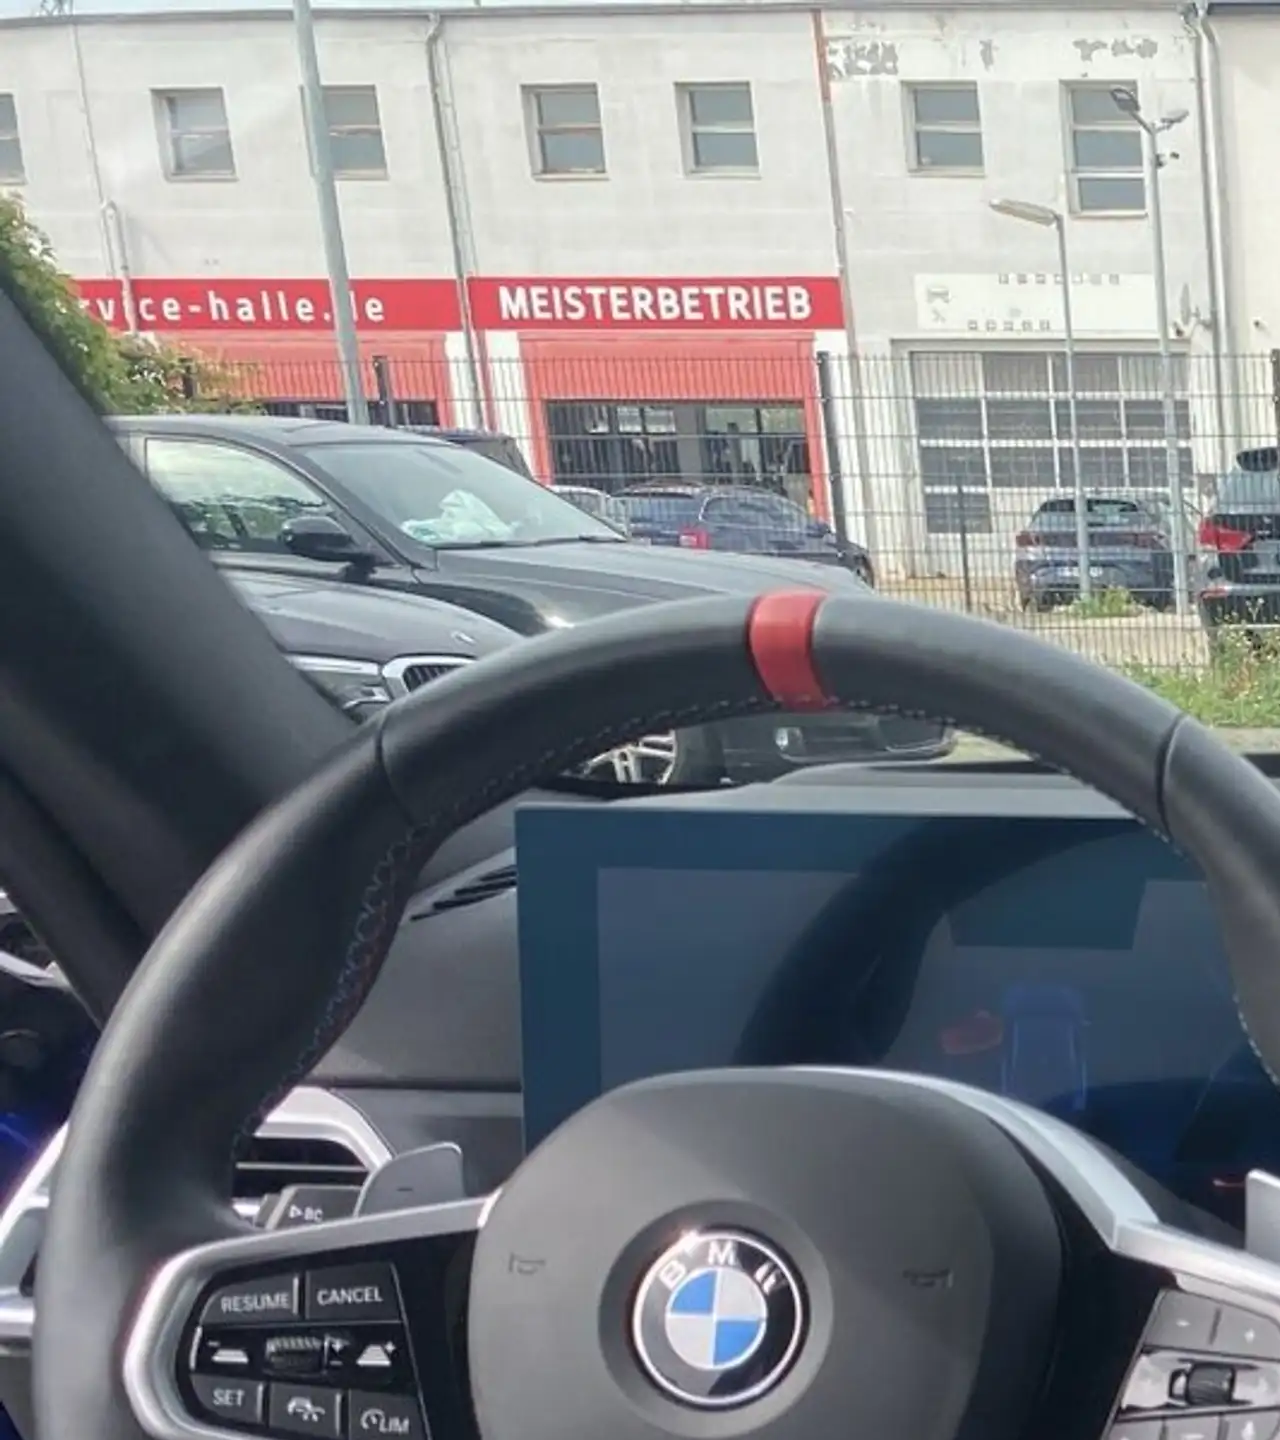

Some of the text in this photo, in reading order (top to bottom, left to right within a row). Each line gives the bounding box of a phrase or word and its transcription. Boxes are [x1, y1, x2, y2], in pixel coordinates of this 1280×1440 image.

[80, 289, 385, 323] vce-halle.e
[499, 285, 812, 321] MEISTERBETRIEB
[220, 1292, 291, 1313] RESUME
[317, 1285, 383, 1306] CANCEL
[212, 1388, 245, 1407] SET
[378, 1413, 410, 1434] LIM
